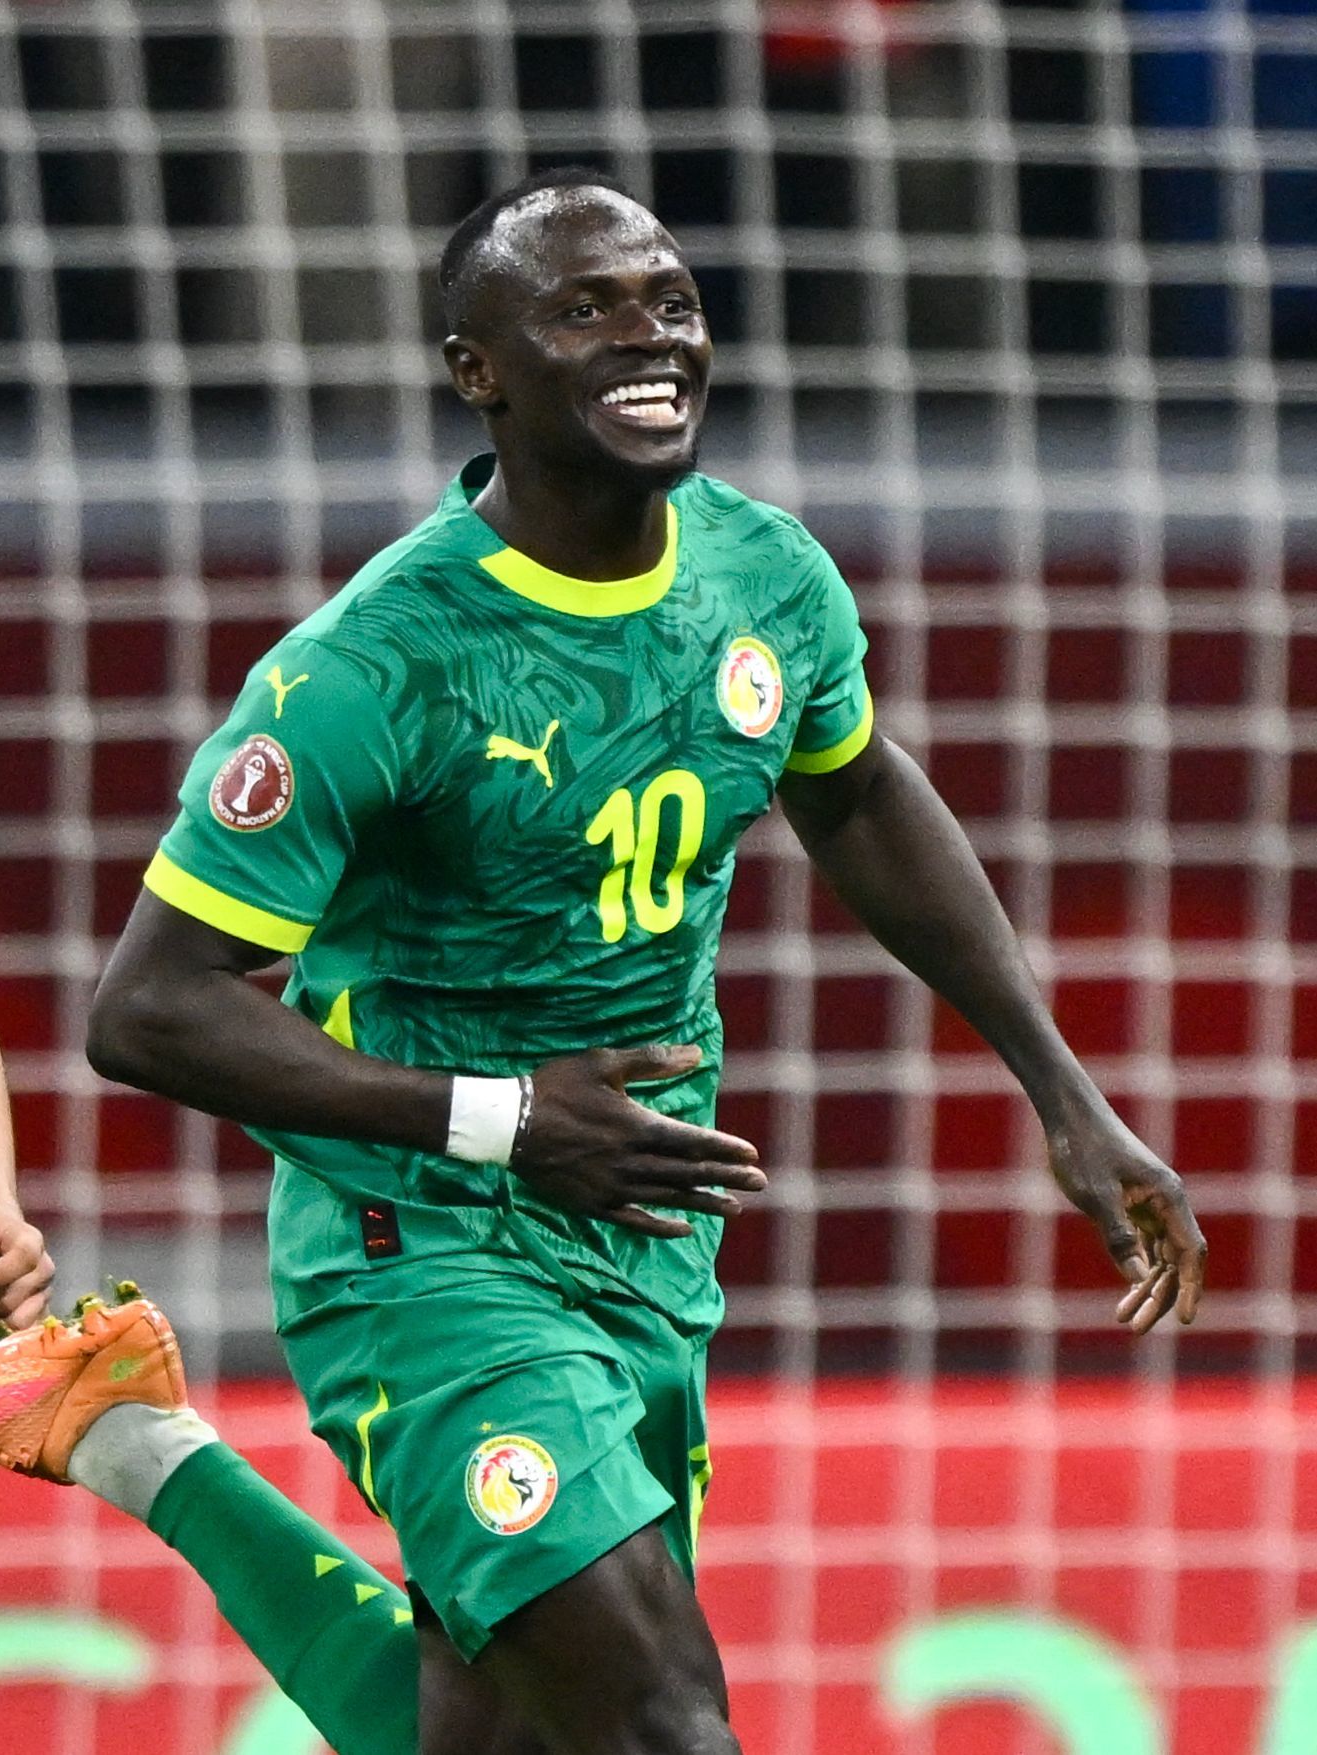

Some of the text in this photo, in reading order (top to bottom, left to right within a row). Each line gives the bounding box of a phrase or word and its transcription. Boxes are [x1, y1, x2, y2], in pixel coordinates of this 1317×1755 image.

[264, 744, 287, 775] AFRICA
[280, 775, 290, 796] CUP
[274, 796, 286, 811] OF
[236, 807, 277, 826] NATIONS
[586, 769, 706, 943] 10
